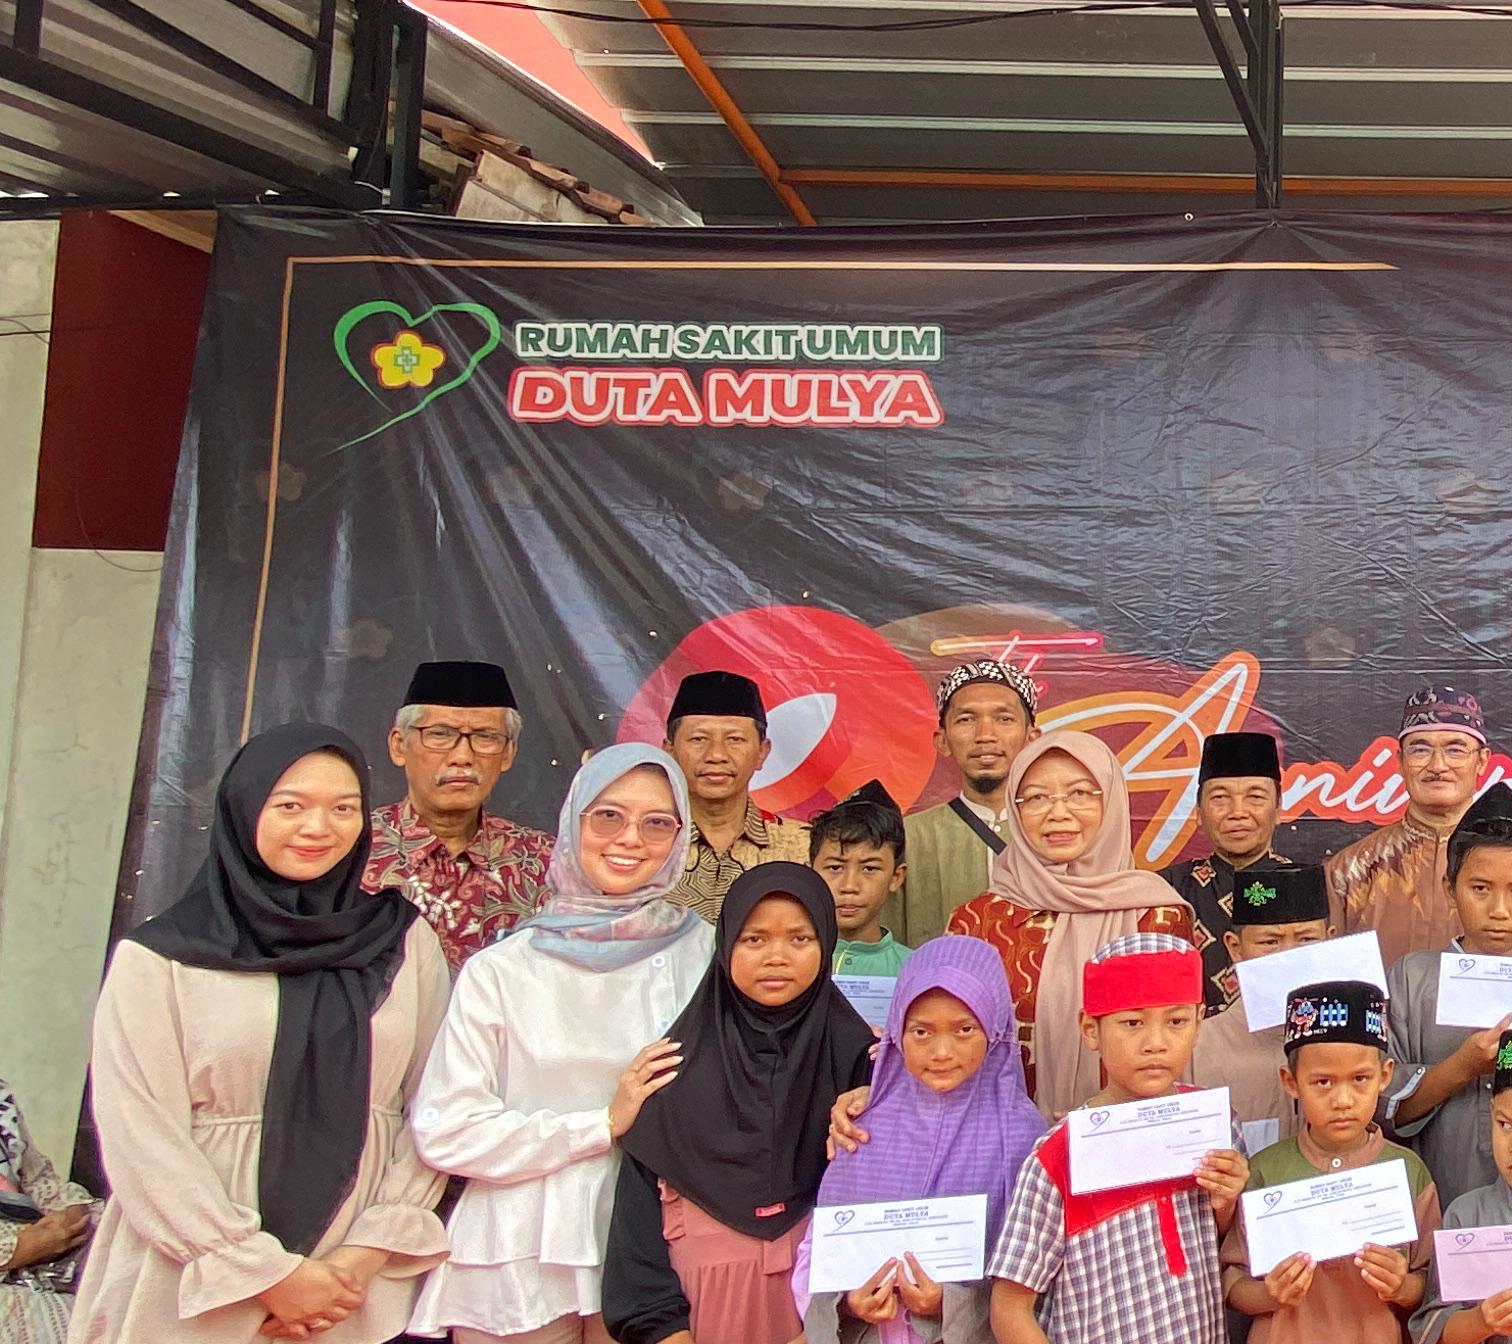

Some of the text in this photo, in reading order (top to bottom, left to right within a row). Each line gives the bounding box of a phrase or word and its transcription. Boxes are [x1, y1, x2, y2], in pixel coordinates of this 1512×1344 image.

[518, 325, 938, 357] RUMAH SAKIT UMUM
[516, 373, 940, 425] DUTA MULYA
